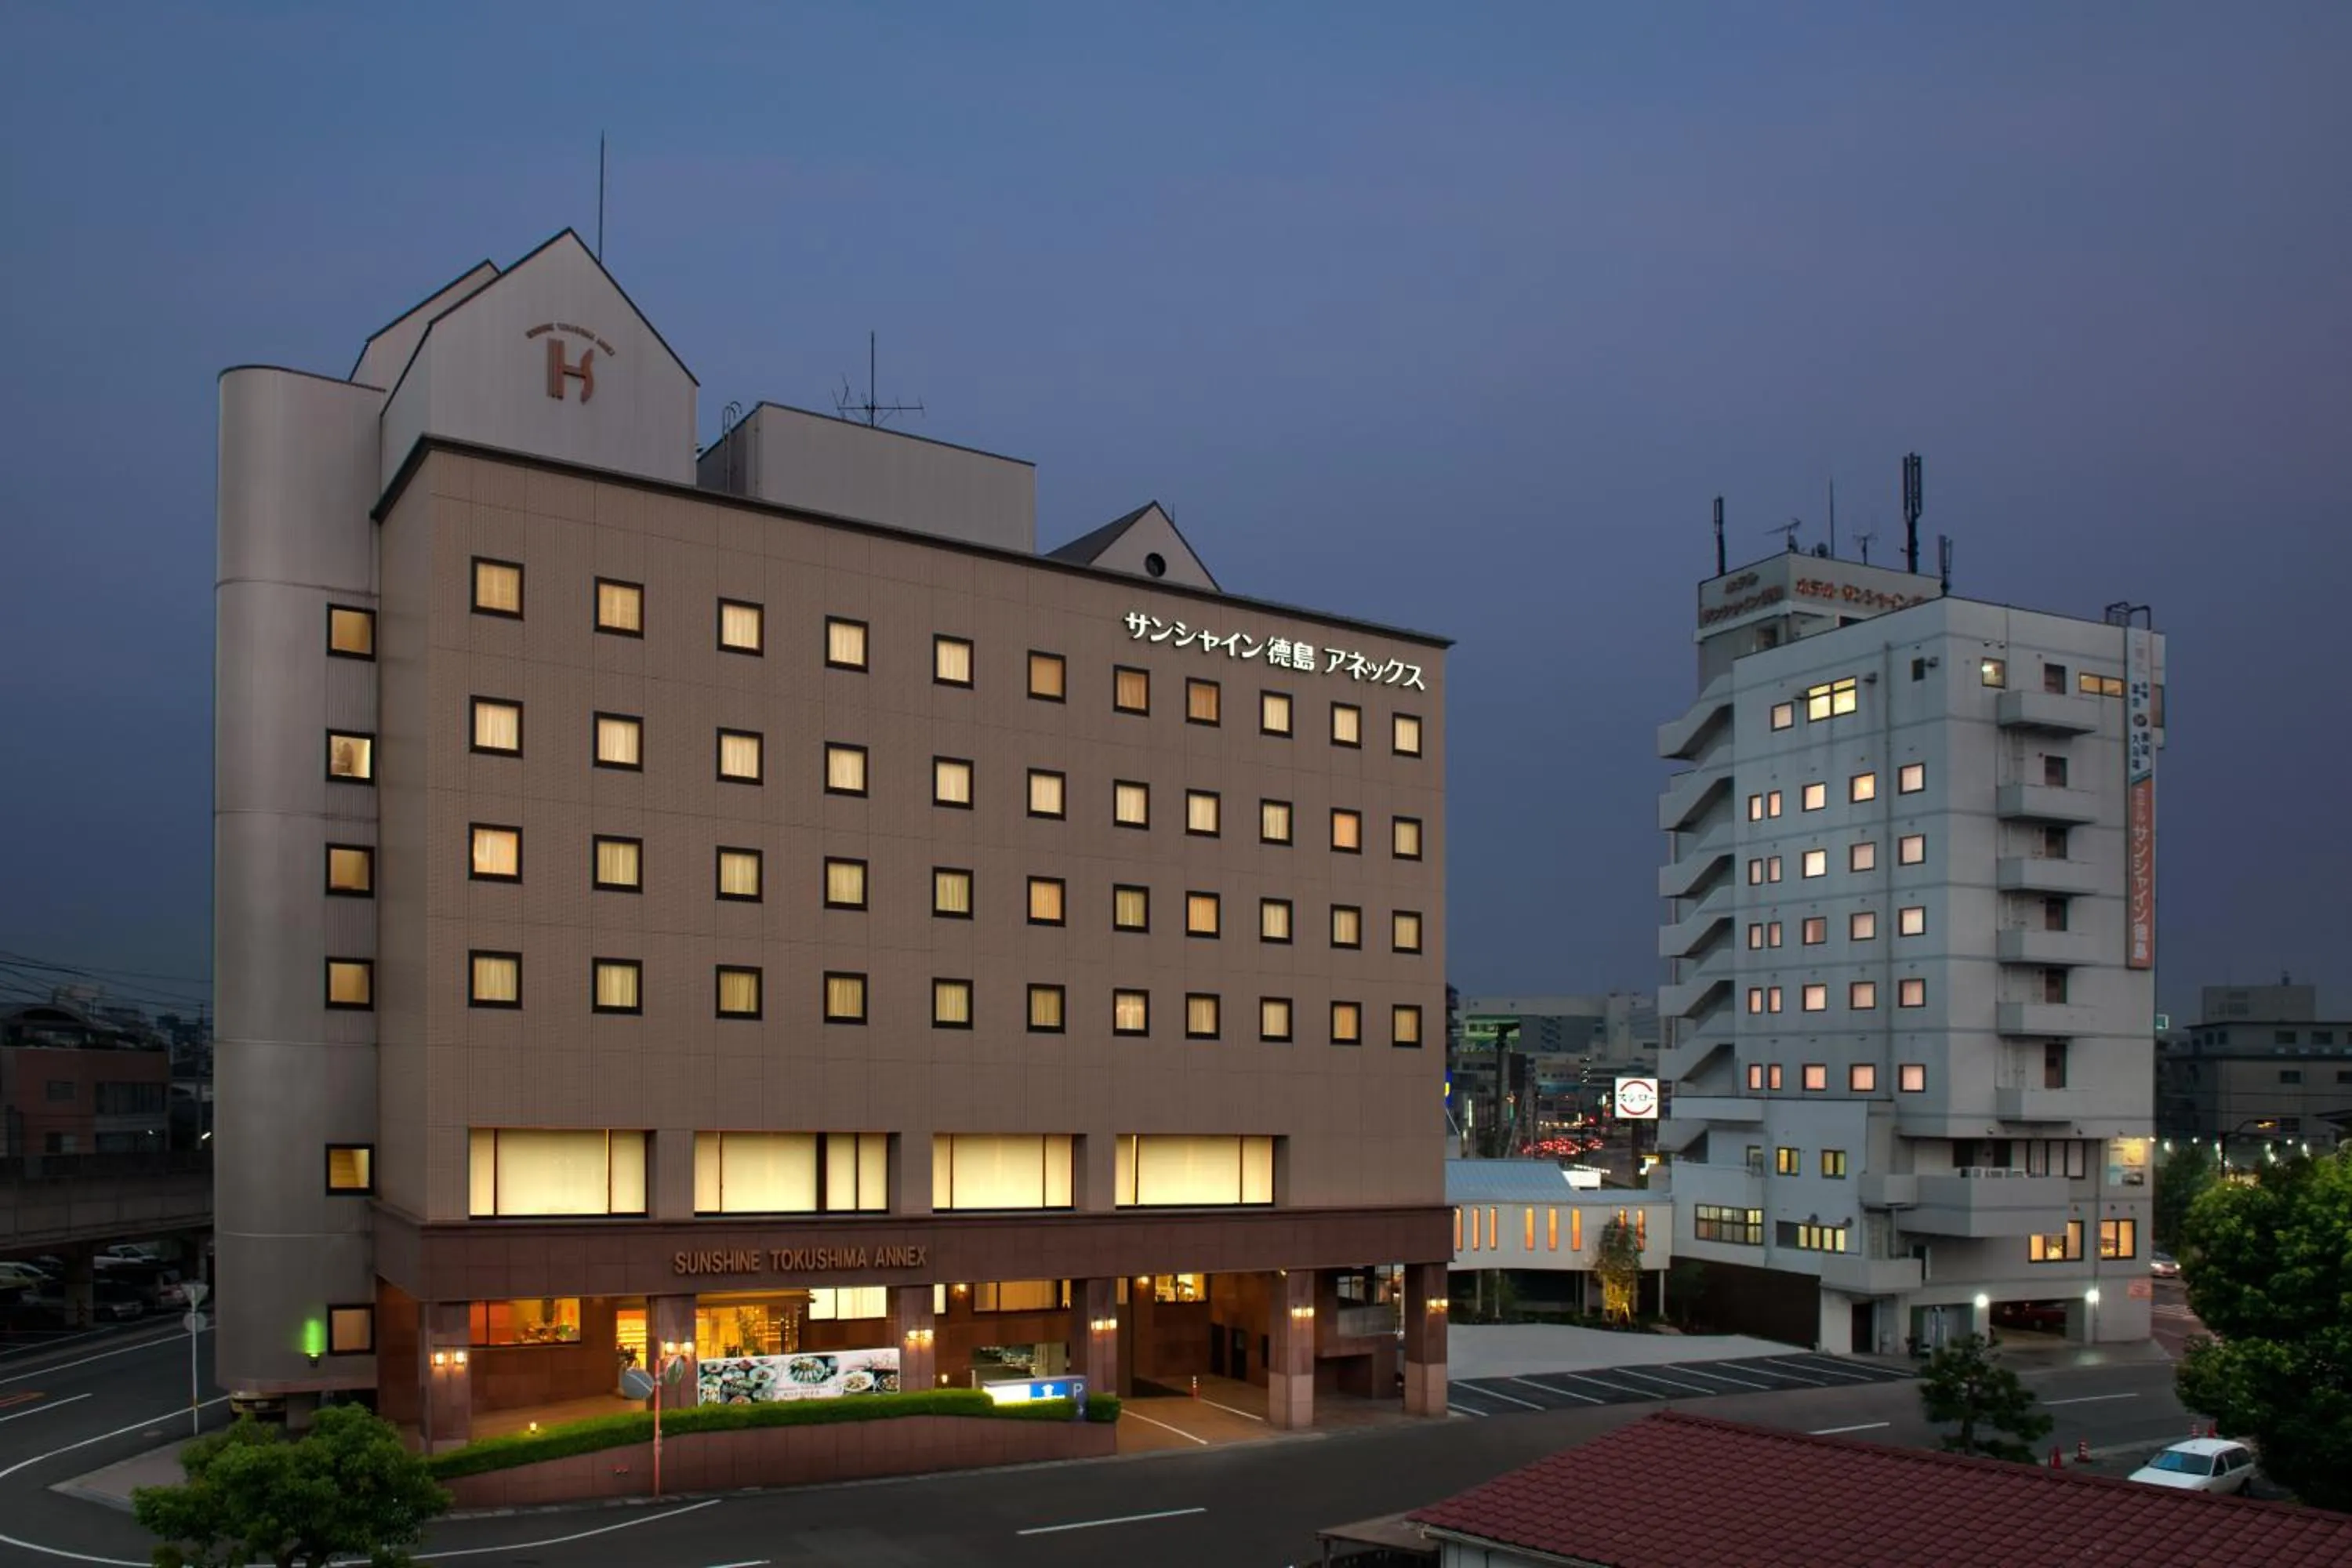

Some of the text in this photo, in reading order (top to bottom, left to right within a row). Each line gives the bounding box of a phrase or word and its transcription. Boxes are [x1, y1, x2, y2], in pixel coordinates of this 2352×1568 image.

[1322, 647, 1425, 691] アネックス
[674, 1246, 927, 1274] SUNSHINE TOKUSHIMA ANNEX
[1073, 1382, 1083, 1399] P
